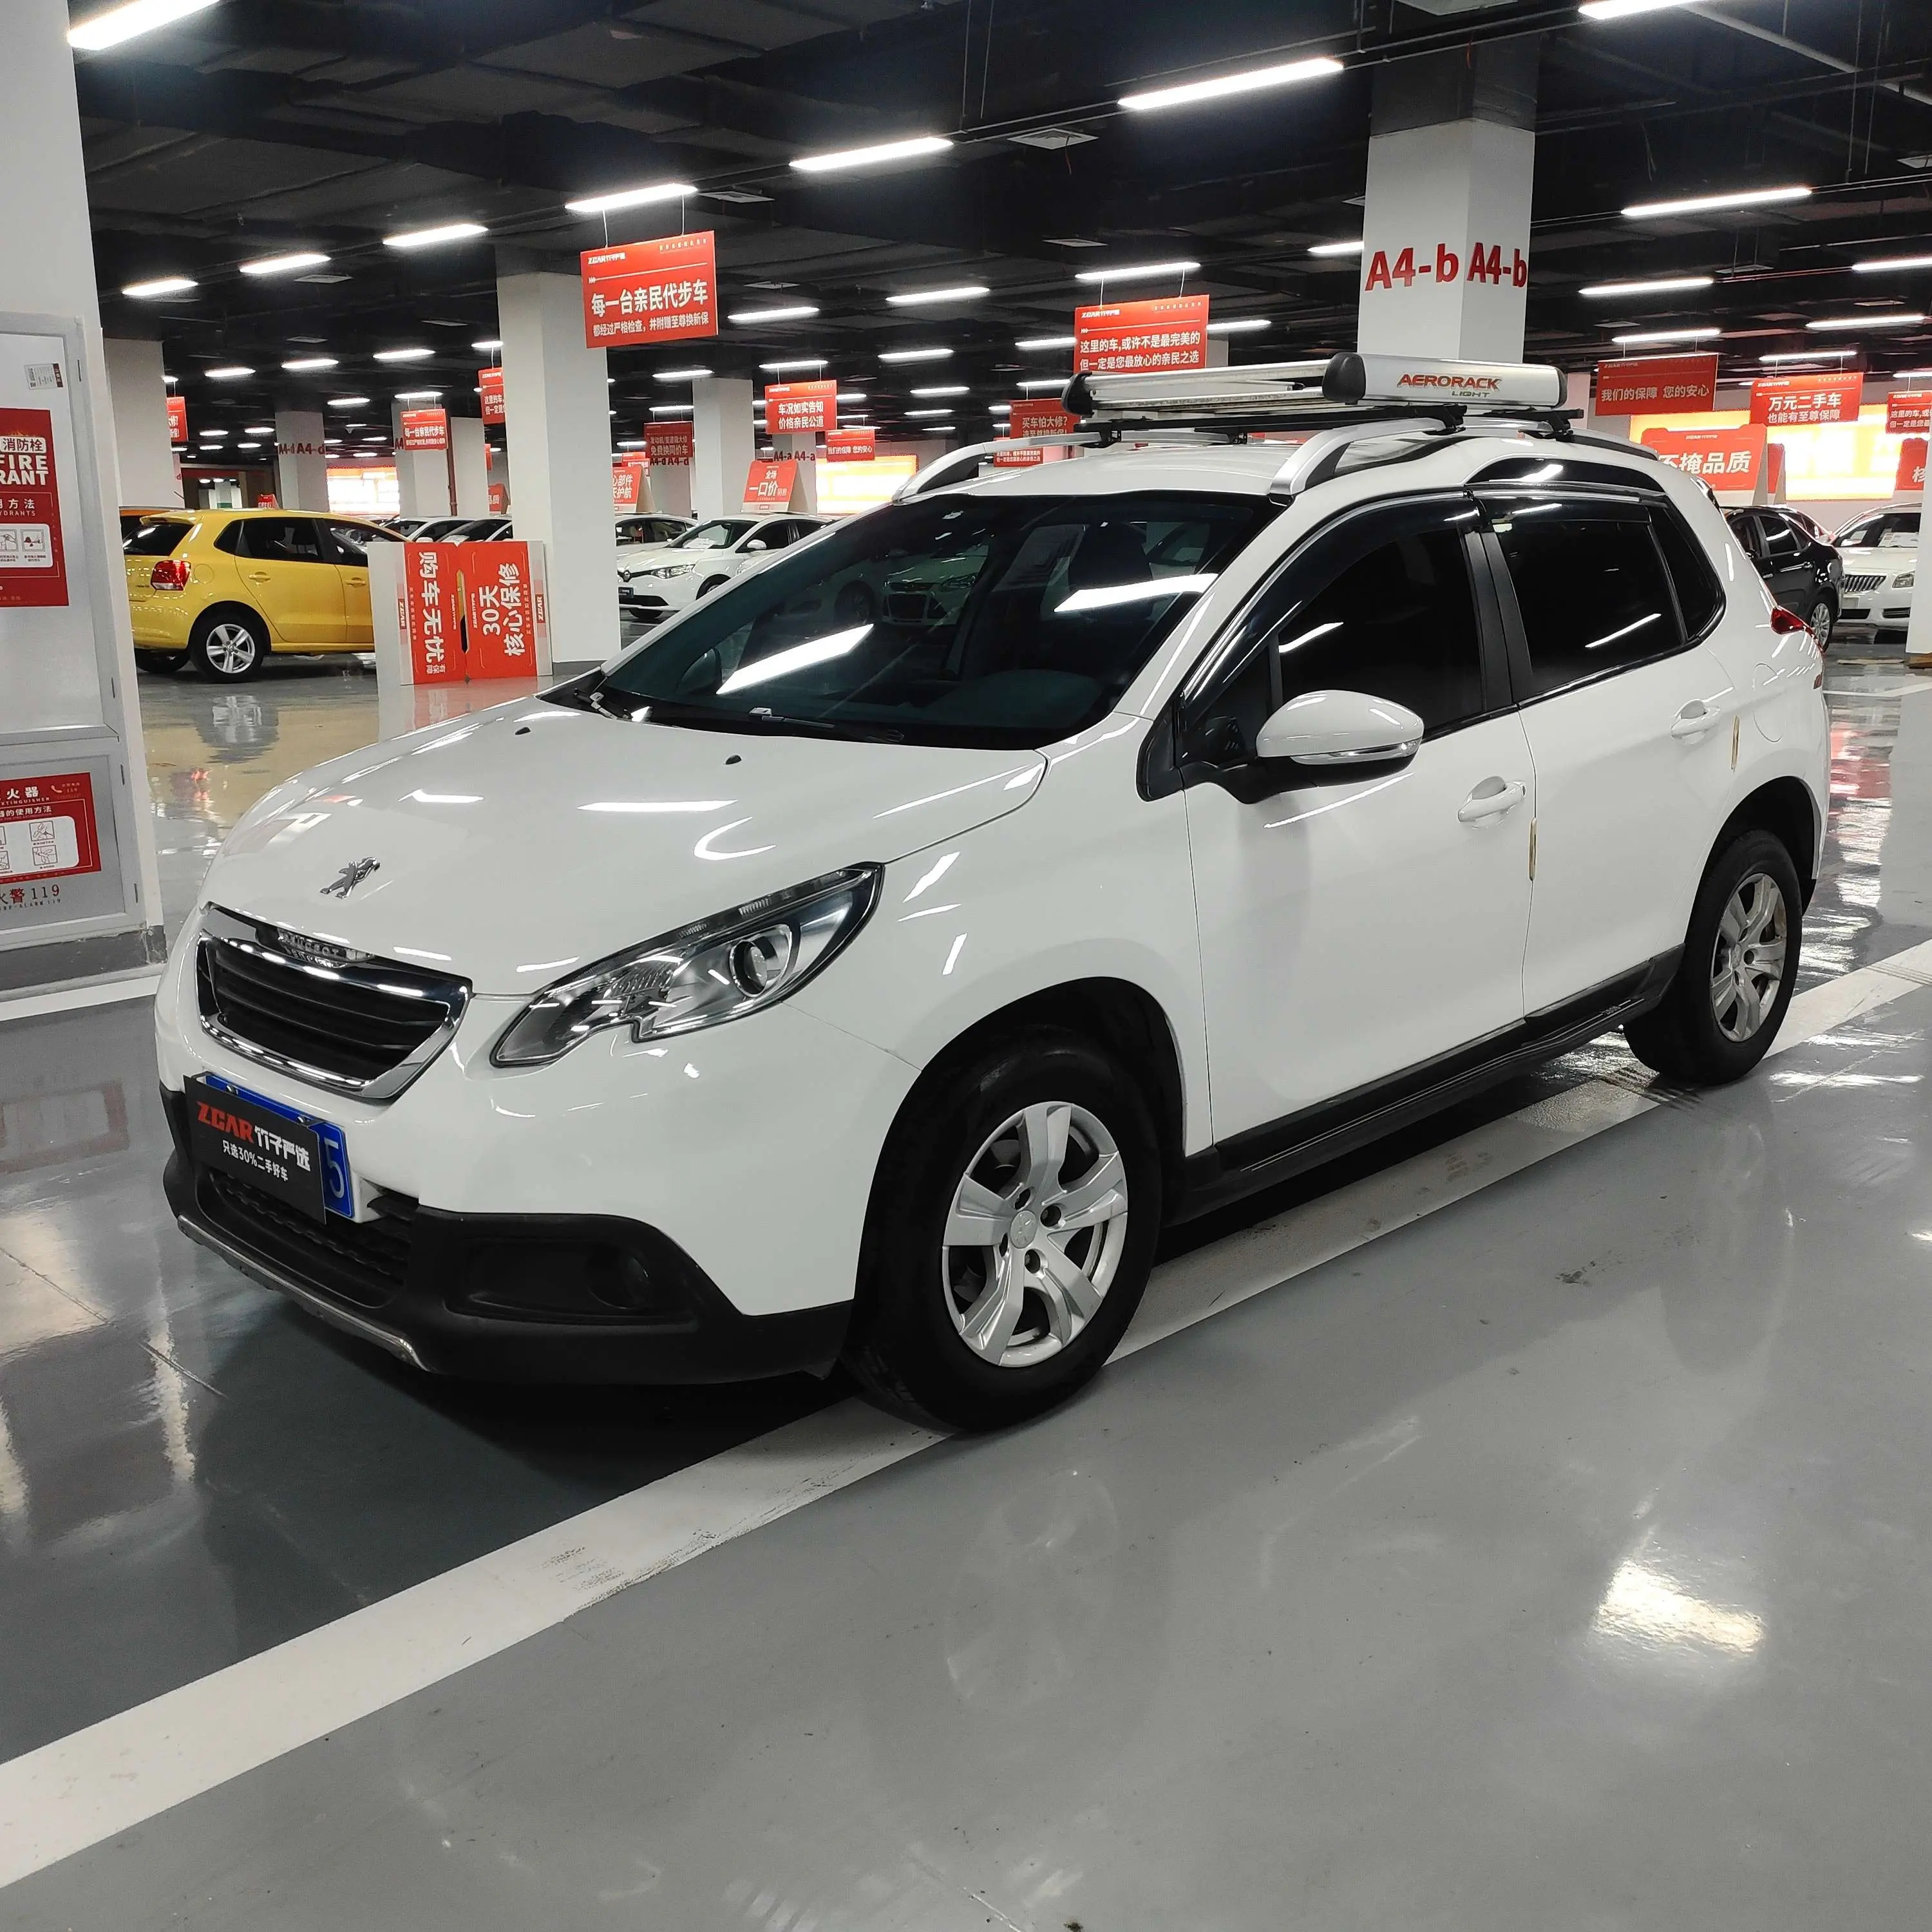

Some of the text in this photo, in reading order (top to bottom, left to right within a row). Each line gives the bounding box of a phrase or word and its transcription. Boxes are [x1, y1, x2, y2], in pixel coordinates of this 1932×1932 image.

[1365, 243, 1459, 290] A4-b
[1467, 242, 1527, 287] A4-b
[591, 279, 708, 317] 每一台亲民代步车
[1080, 350, 1199, 372] 但一定是您最放心的亲民之选
[1397, 374, 1502, 391] AERORACK
[1601, 384, 1709, 401] 我们的保障 您的安心
[778, 401, 824, 415] 车况如实告知
[1768, 392, 1842, 412] 万元二手车
[779, 415, 824, 430] 价格亲民公道
[1767, 410, 1841, 423] 也能有至尊保障
[3, 438, 43, 451] 消防栓
[297, 442, 325, 455] A4-d
[773, 451, 792, 461] A4-a
[794, 451, 815, 461] A4-a
[419, 551, 444, 663] 购车无忧
[478, 585, 500, 636] 30天
[498, 563, 526, 656] 核心保修
[31, 884, 60, 900] 119
[222, 1139, 289, 1182] 只选30%二手好车
[324, 1137, 345, 1198] 5
